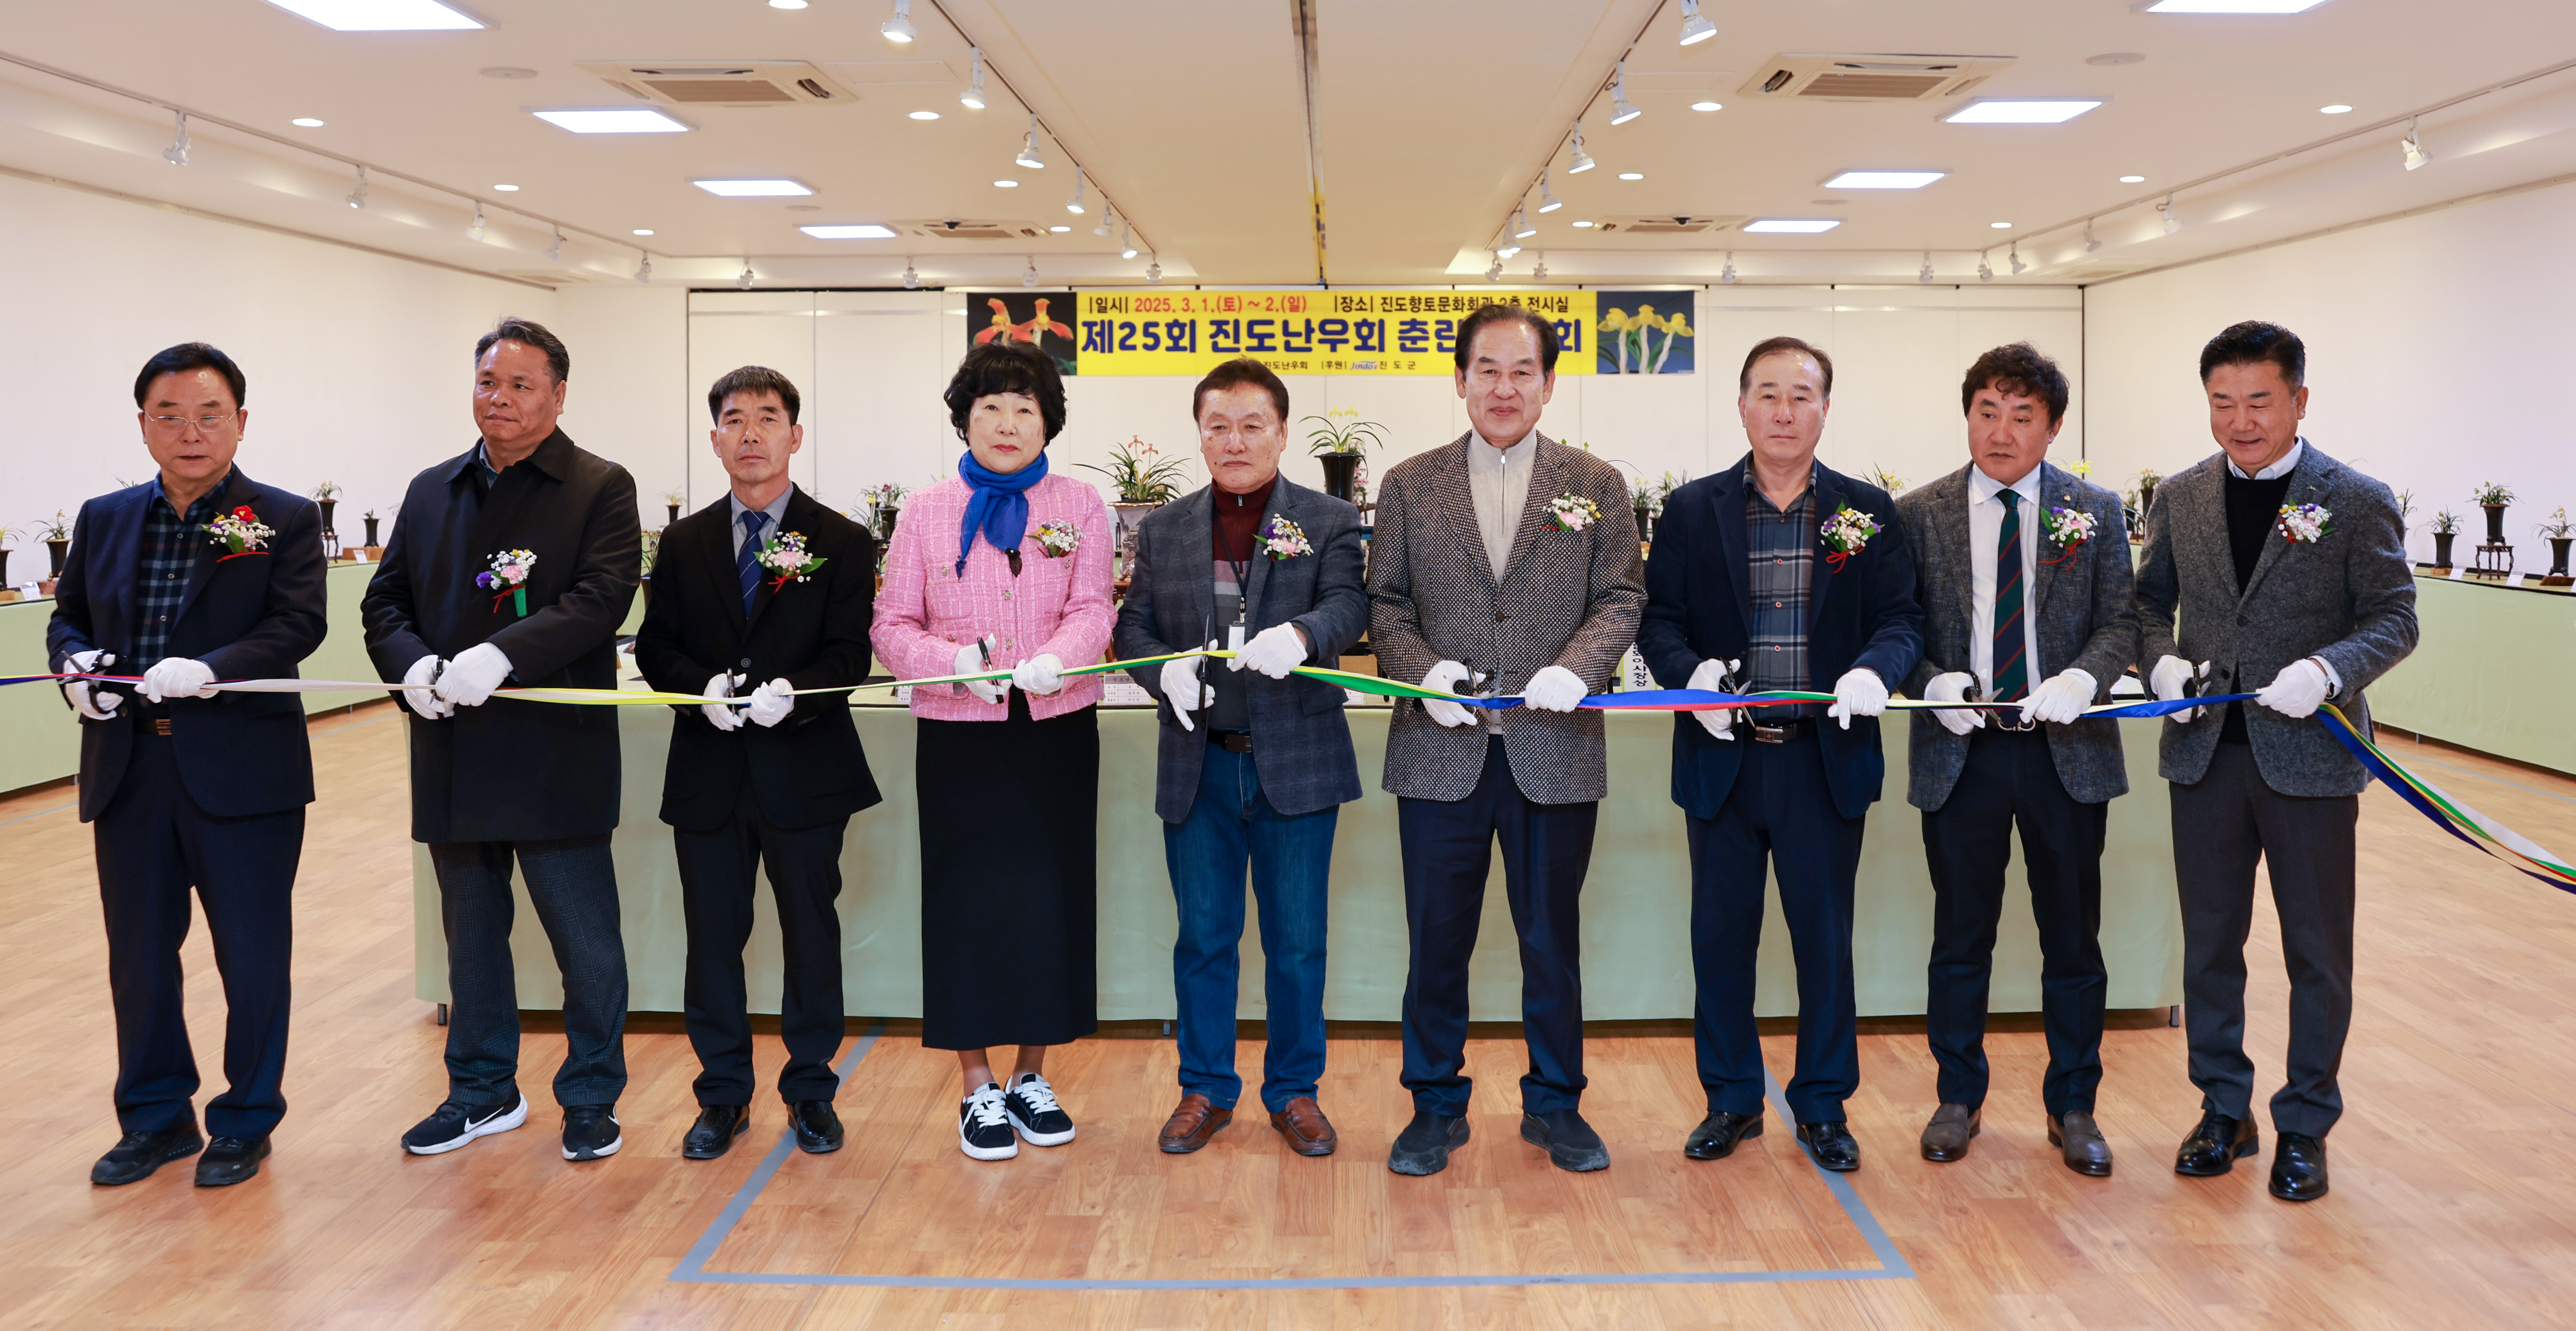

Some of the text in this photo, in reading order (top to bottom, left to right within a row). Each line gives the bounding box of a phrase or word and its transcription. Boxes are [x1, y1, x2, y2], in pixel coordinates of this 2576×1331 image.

[1135, 297, 1176, 313] 2025.
[1182, 297, 1195, 313] 3.
[1202, 295, 1242, 313] 1.(토)
[1265, 295, 1307, 313] 2.(일)
[1527, 296, 1568, 313] 전시실
[1081, 319, 1196, 353] 제25회
[1209, 318, 1385, 353] 진도난우회
